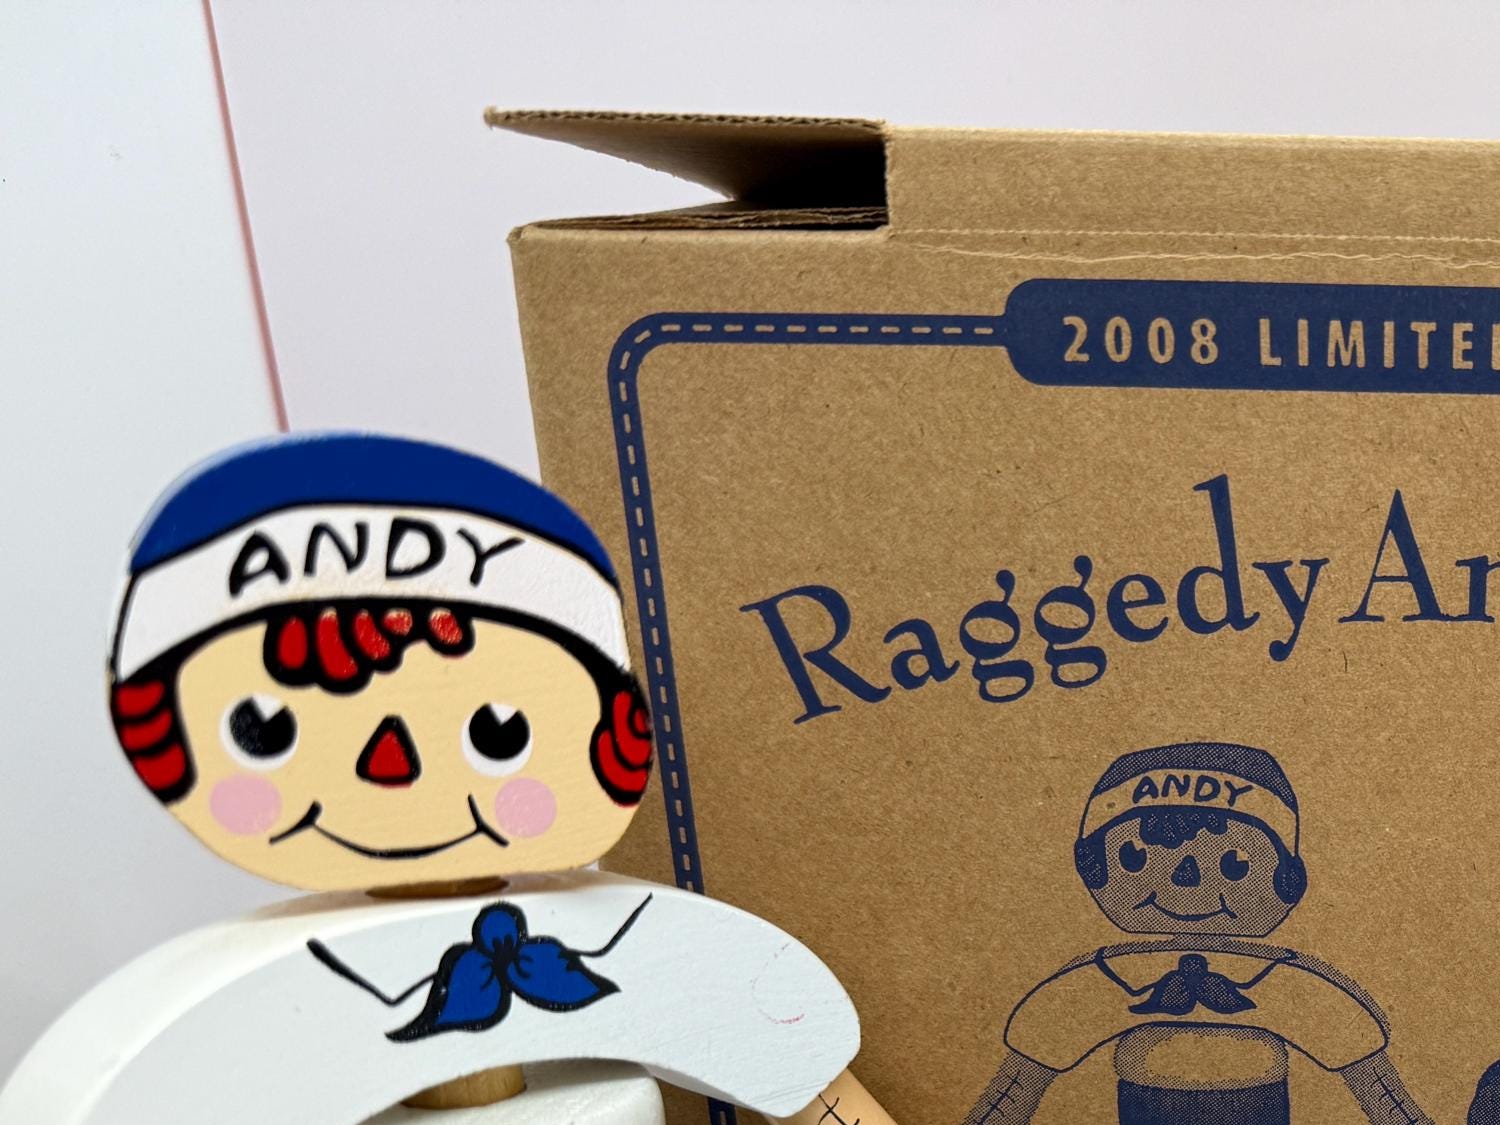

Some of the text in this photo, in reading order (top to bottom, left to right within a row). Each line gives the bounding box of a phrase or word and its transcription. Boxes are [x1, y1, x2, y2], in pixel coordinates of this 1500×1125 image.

[1064, 315, 1218, 365] 2008
[229, 516, 525, 598] ANDY
[743, 474, 1330, 723] Raggedy
[1132, 774, 1253, 807] ANDY
